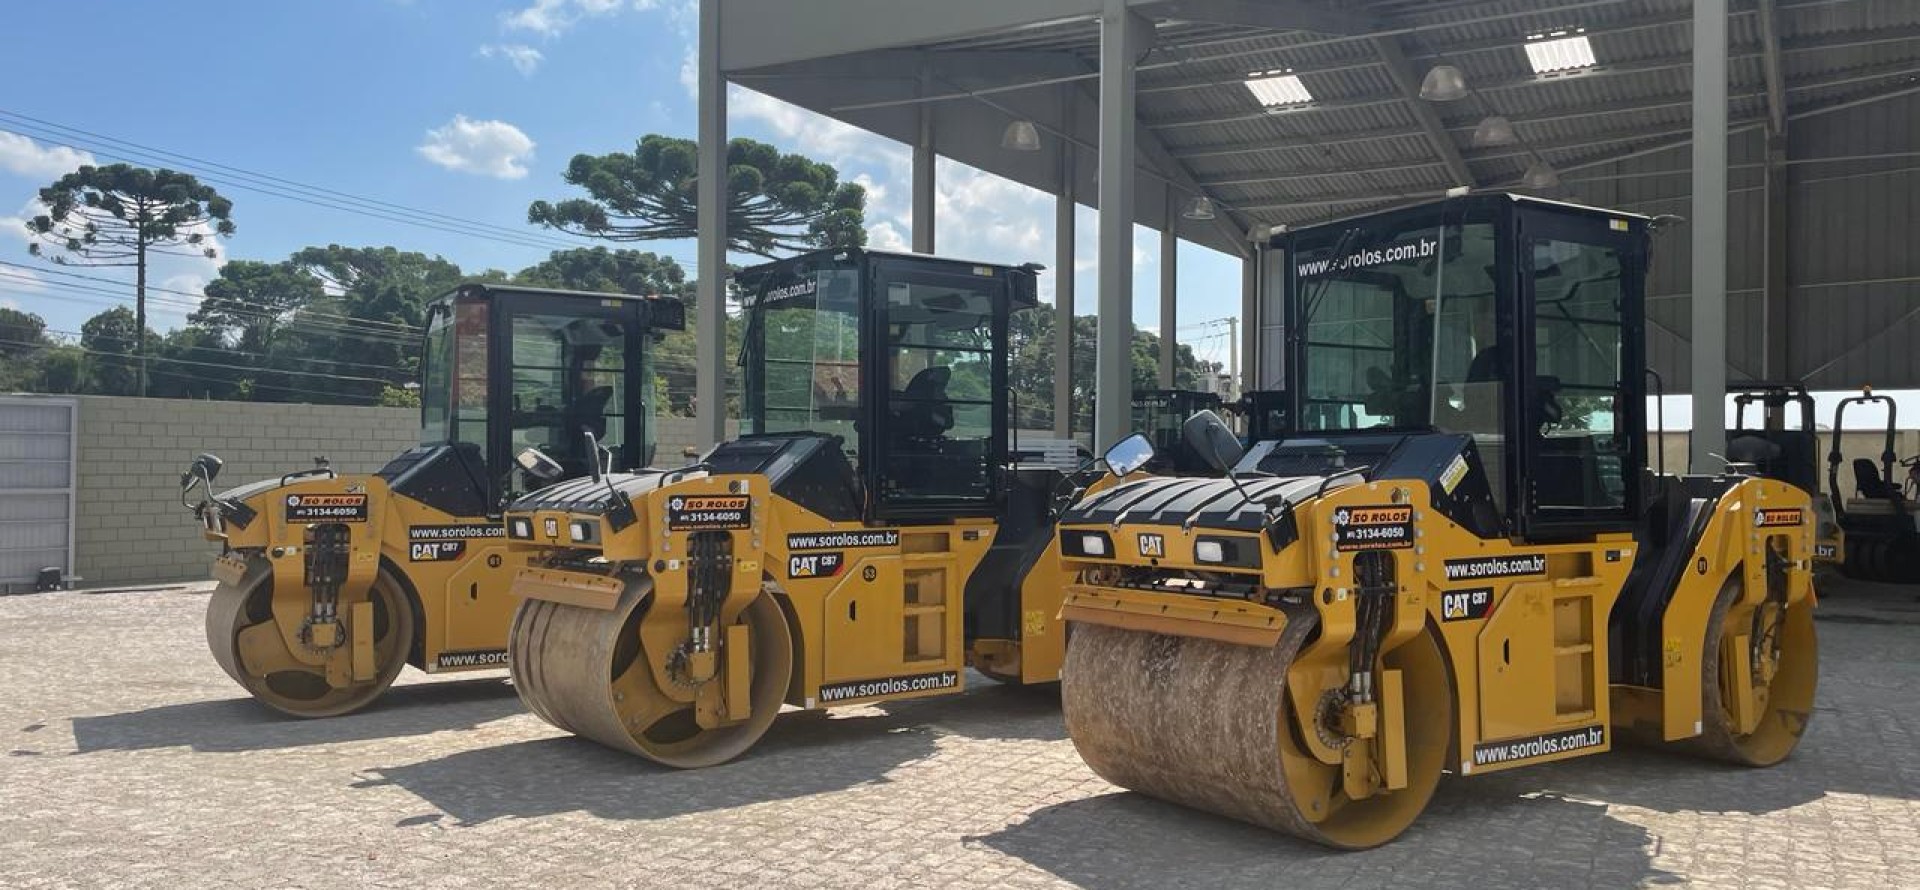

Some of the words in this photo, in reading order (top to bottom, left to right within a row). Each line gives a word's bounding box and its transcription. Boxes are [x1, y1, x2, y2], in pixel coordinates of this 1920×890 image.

[705, 500, 745, 508] ROLOS
[690, 512, 741, 522] 3134-6050
[1370, 511, 1408, 522] ROLOS
[789, 531, 898, 548] www.sorolos.com.br
[1355, 527, 1404, 540] 3134-6050
[412, 543, 439, 560] CAT
[1139, 535, 1162, 556] CAT
[791, 556, 818, 576] CAT
[1445, 555, 1545, 577] www.sorolos.com.br
[1444, 593, 1470, 618] CAT
[821, 672, 957, 701] www.sorolos.com.br
[1475, 727, 1602, 765] www.sorolos.com.br
